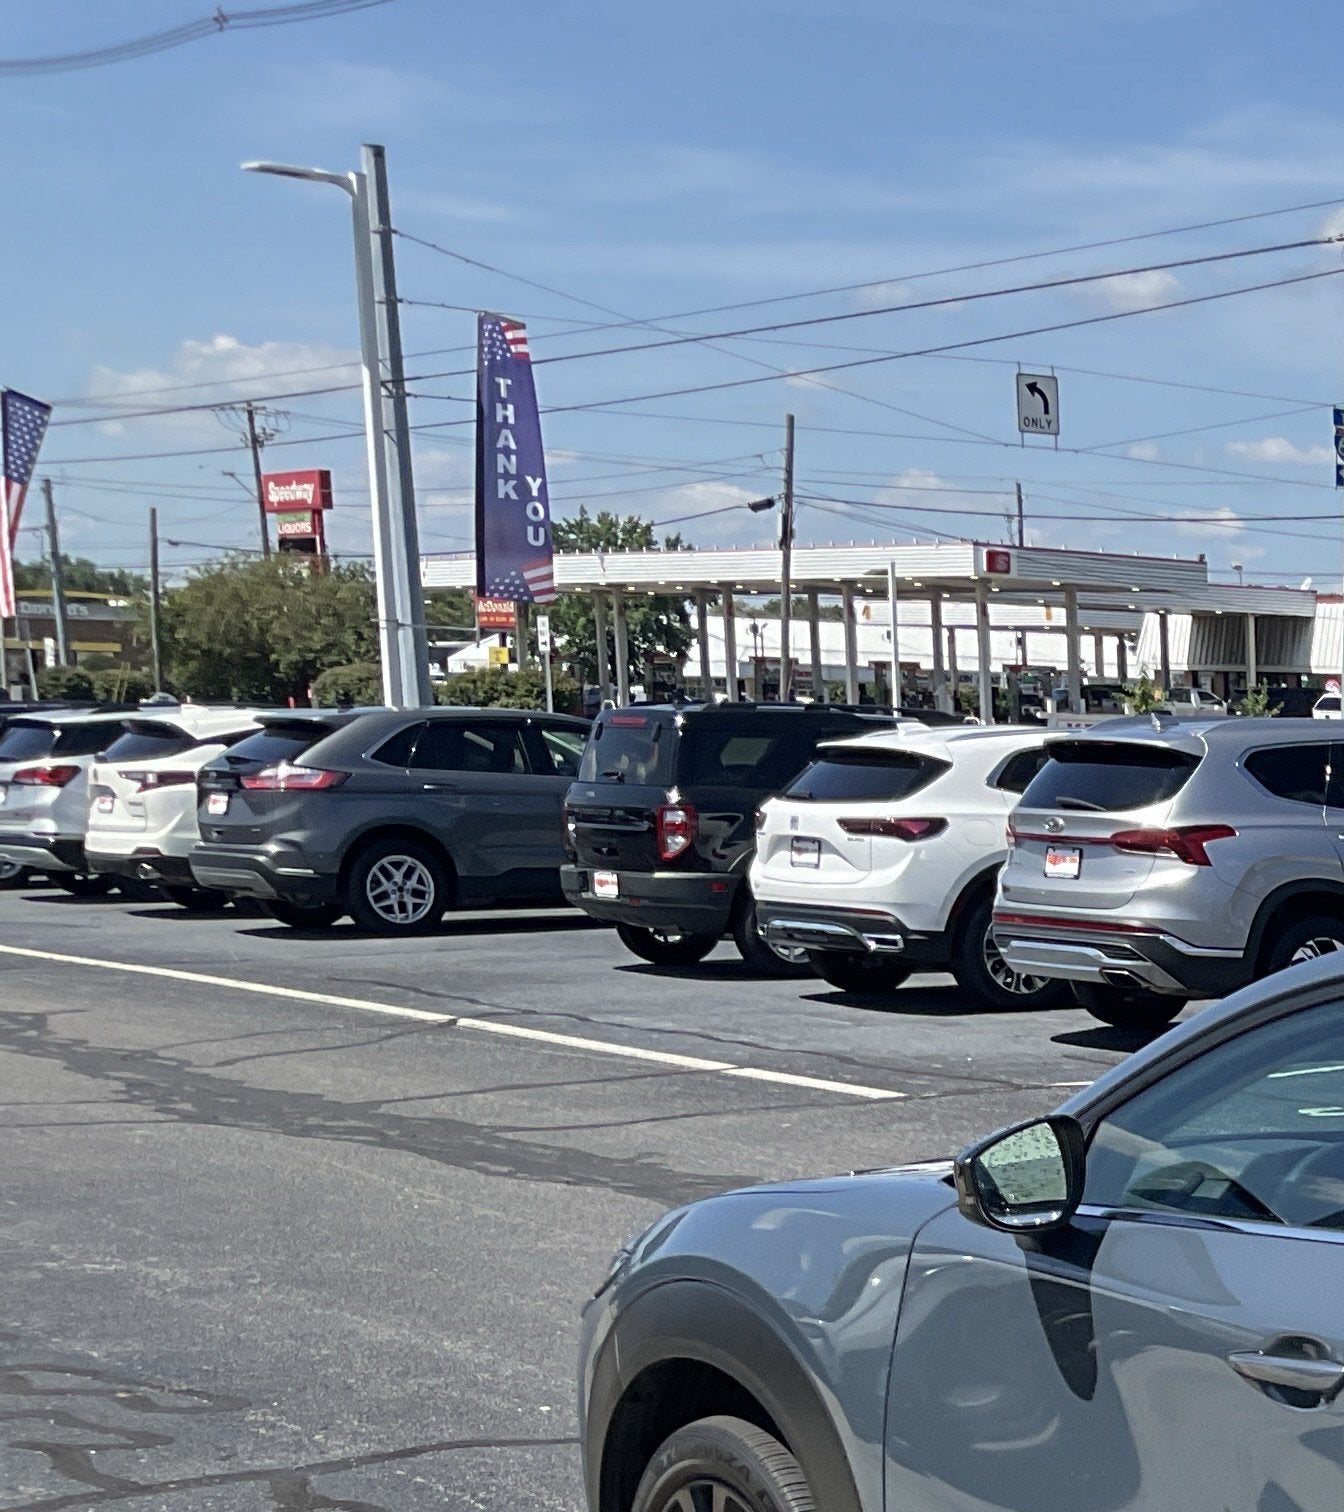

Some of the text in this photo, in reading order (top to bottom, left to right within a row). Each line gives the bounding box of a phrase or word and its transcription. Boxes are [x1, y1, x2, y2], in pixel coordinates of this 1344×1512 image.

[1023, 416, 1052, 430] ONLY
[495, 377, 517, 500] THANK
[268, 480, 314, 507] Speedway
[525, 475, 545, 546] YOU
[278, 521, 312, 534] LIQUORS
